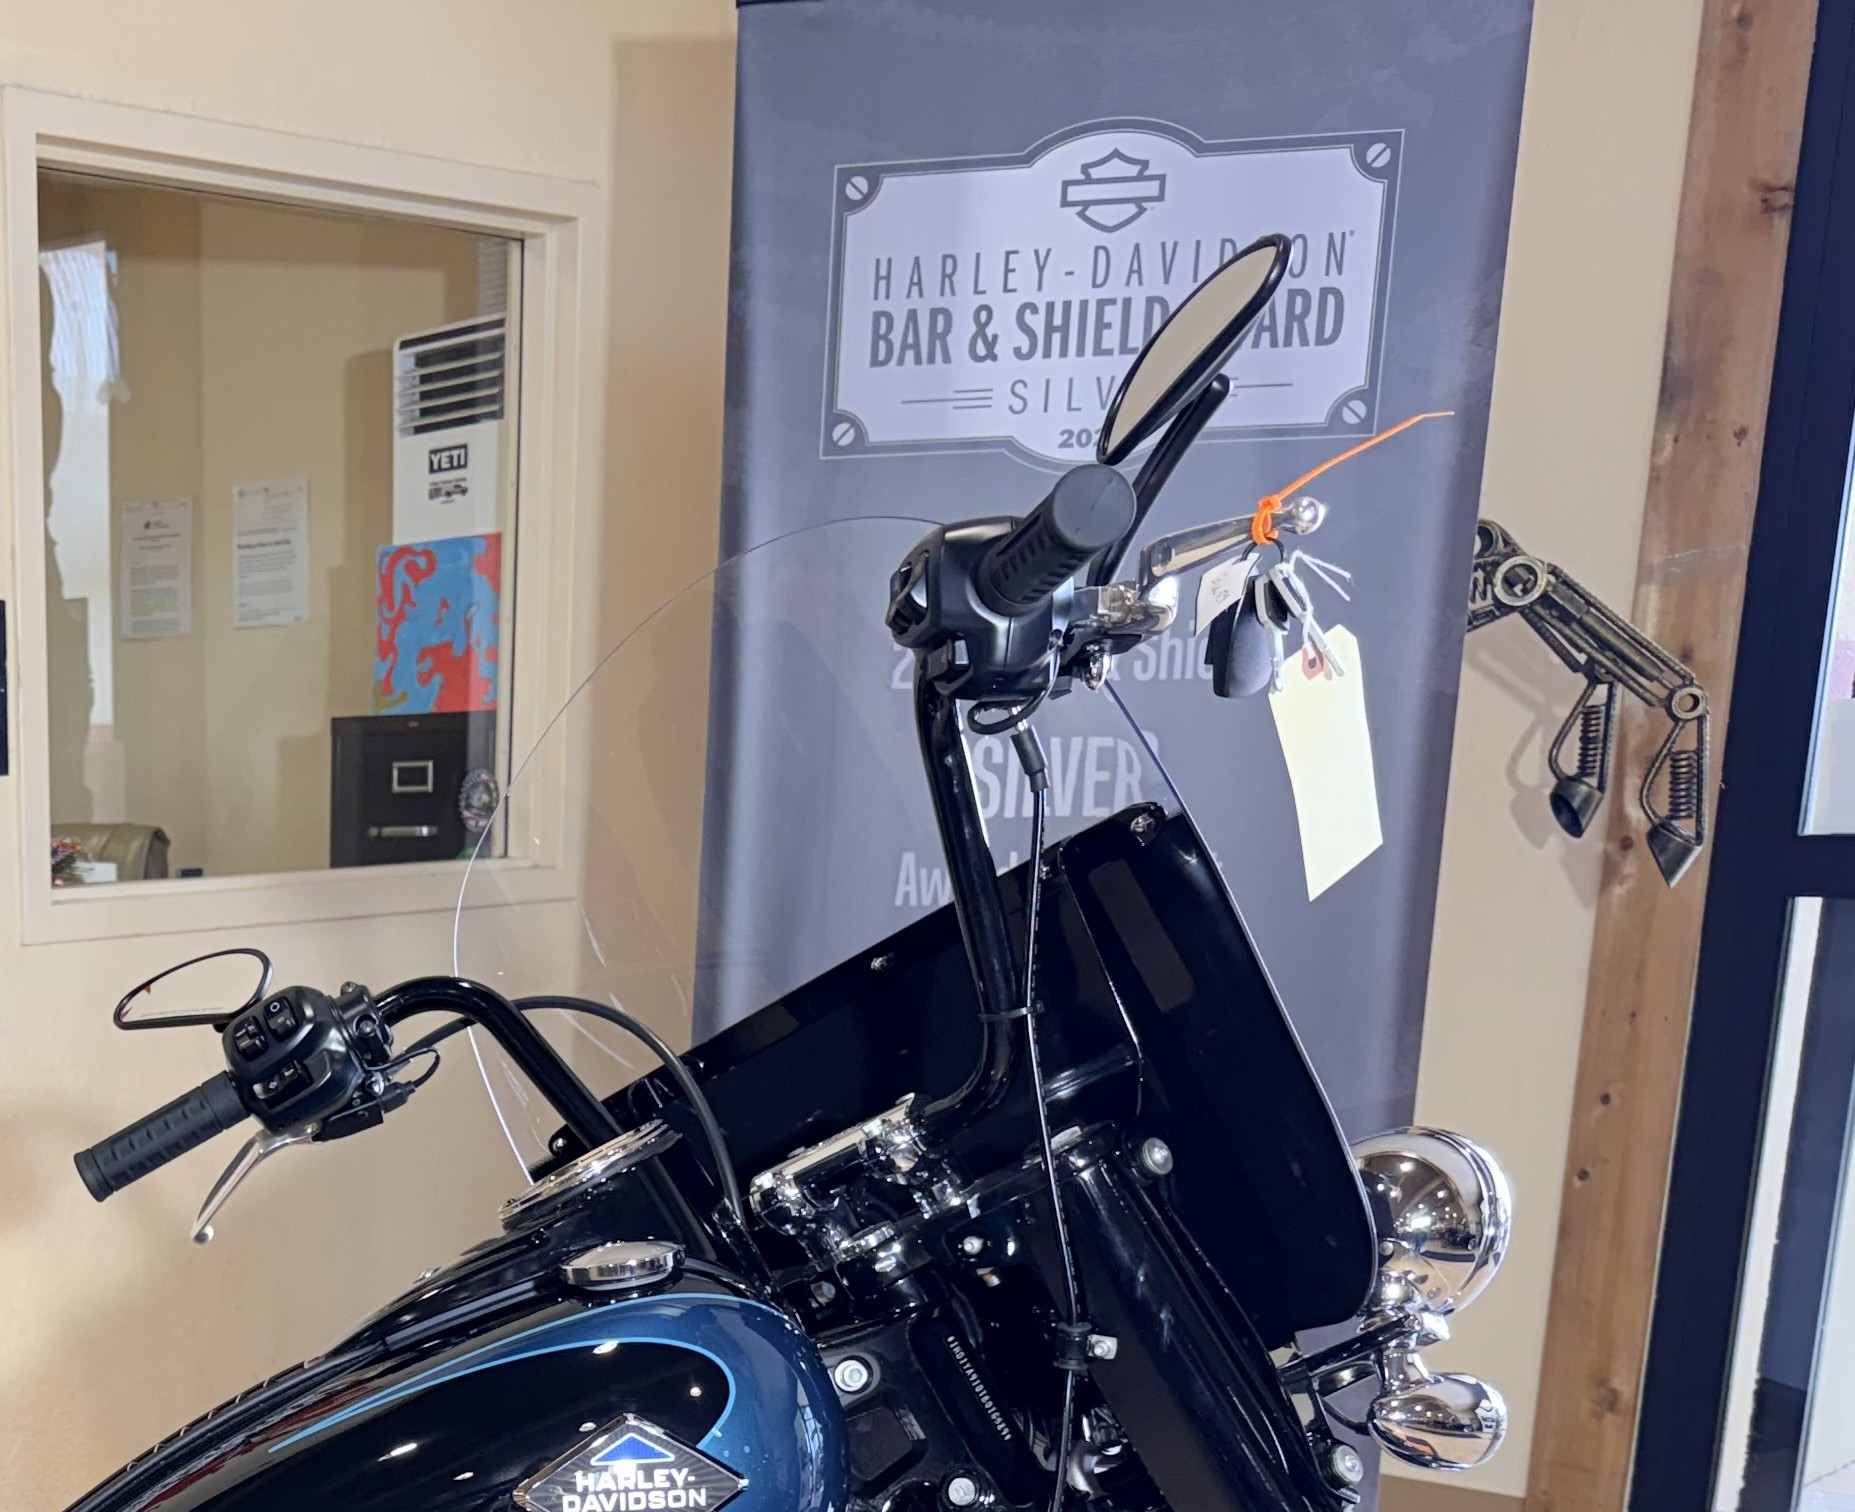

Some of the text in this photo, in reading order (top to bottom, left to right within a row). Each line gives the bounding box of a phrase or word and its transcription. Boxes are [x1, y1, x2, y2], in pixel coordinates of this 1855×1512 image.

[873, 231, 1346, 301] HARLEY-DAVIDON
[870, 306, 953, 368] BAR
[967, 304, 999, 363] &
[1008, 375, 1116, 415] SILV
[1057, 428, 1101, 449] 20
[430, 448, 466, 471] YETI
